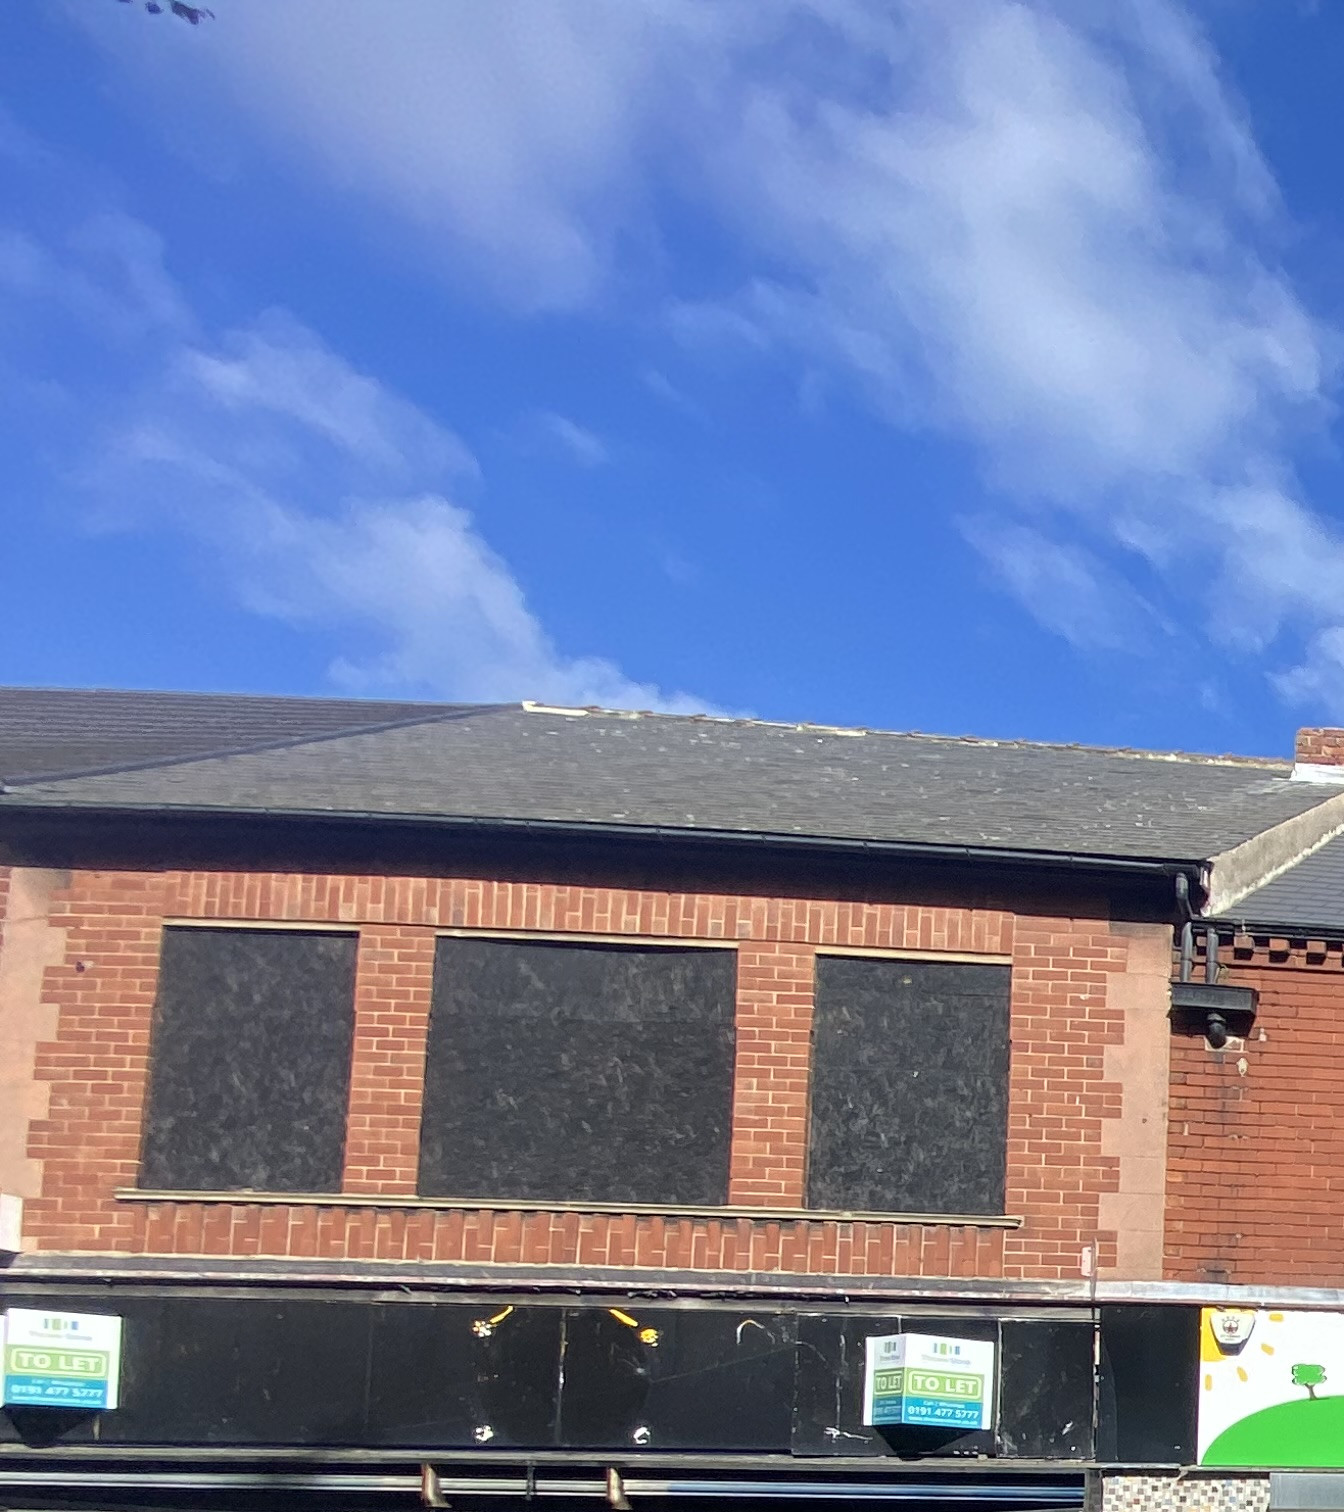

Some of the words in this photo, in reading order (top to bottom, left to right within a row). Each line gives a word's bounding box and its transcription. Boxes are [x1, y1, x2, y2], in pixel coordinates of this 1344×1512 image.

[19, 1351, 51, 1368] TO
[58, 1355, 101, 1371] LET
[876, 1376, 887, 1390] TO
[888, 1375, 901, 1389] LET
[914, 1375, 939, 1390] TO
[946, 1378, 976, 1393] LET
[908, 1405, 931, 1416] 0191
[934, 1407, 953, 1417] 477
[955, 1409, 979, 1419] 5777
